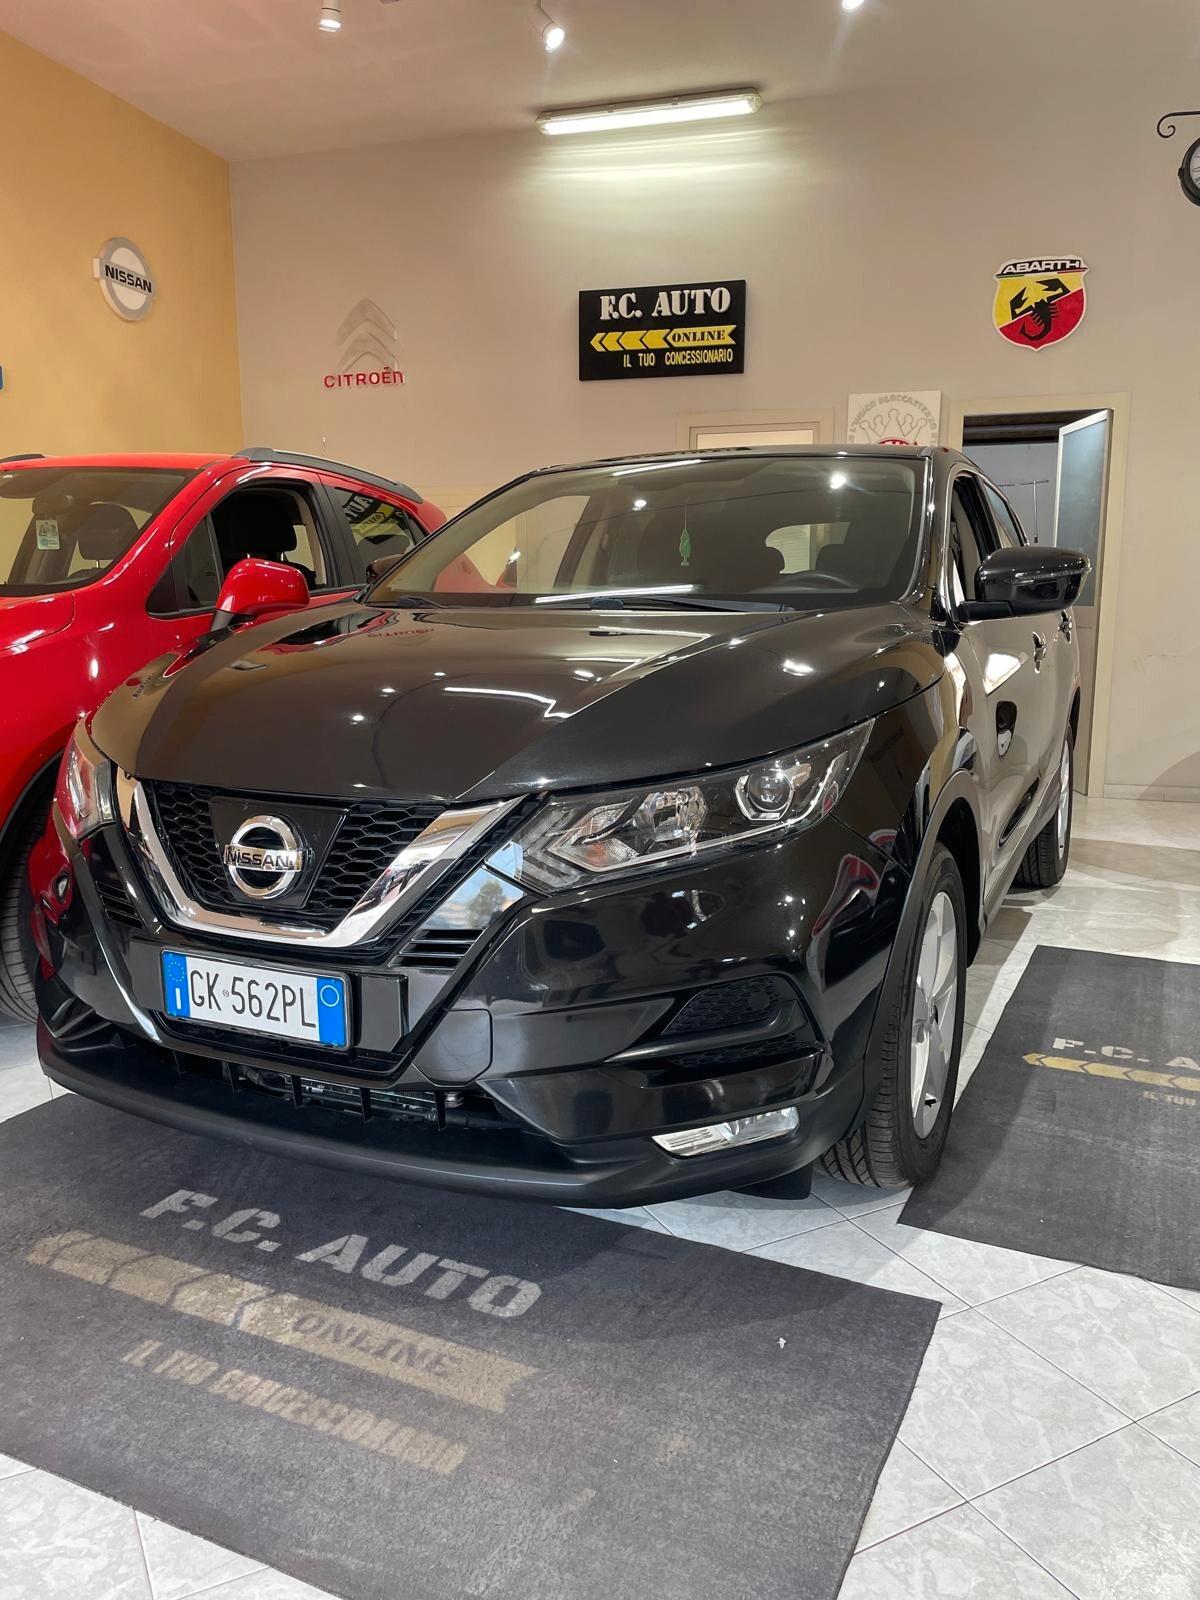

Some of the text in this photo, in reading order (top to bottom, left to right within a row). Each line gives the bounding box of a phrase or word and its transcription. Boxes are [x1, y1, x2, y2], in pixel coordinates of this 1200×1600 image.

[105, 264, 152, 293] NISSAN
[1002, 260, 1080, 274] ABARTH
[600, 287, 731, 320] F.C. AUTO
[671, 329, 726, 343] ONLINE
[623, 348, 733, 368] IL TUO CONCESSIONARIO
[225, 849, 295, 869] NISSAN
[1052, 1037, 1150, 1063] F.C.
[139, 1189, 543, 1317] F.C. AUTO
[291, 1312, 460, 1377] ONLINE
